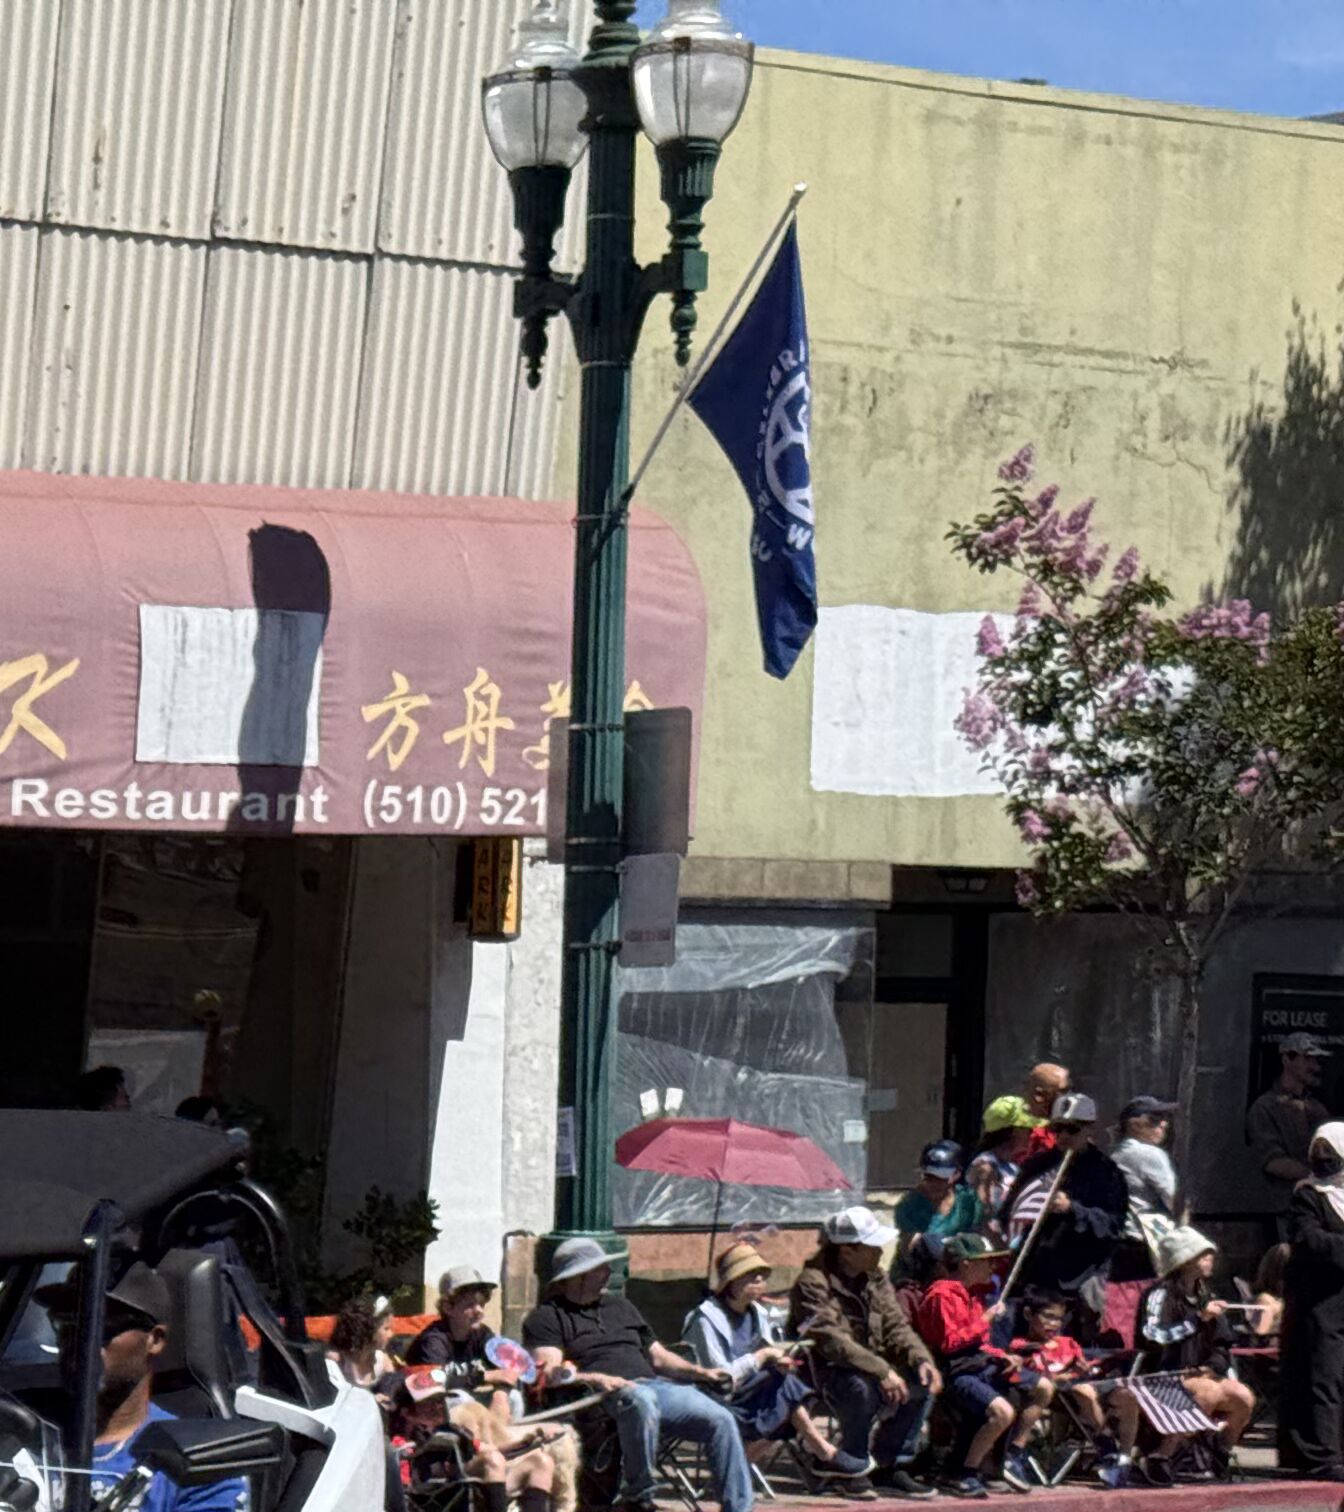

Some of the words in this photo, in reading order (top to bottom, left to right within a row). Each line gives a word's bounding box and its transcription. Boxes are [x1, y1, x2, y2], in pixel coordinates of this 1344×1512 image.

[11, 778, 330, 823] Restaurant
[363, 779, 468, 828] (510)
[1262, 1009, 1289, 1027] FOR
[1290, 1010, 1329, 1028] LEASE
